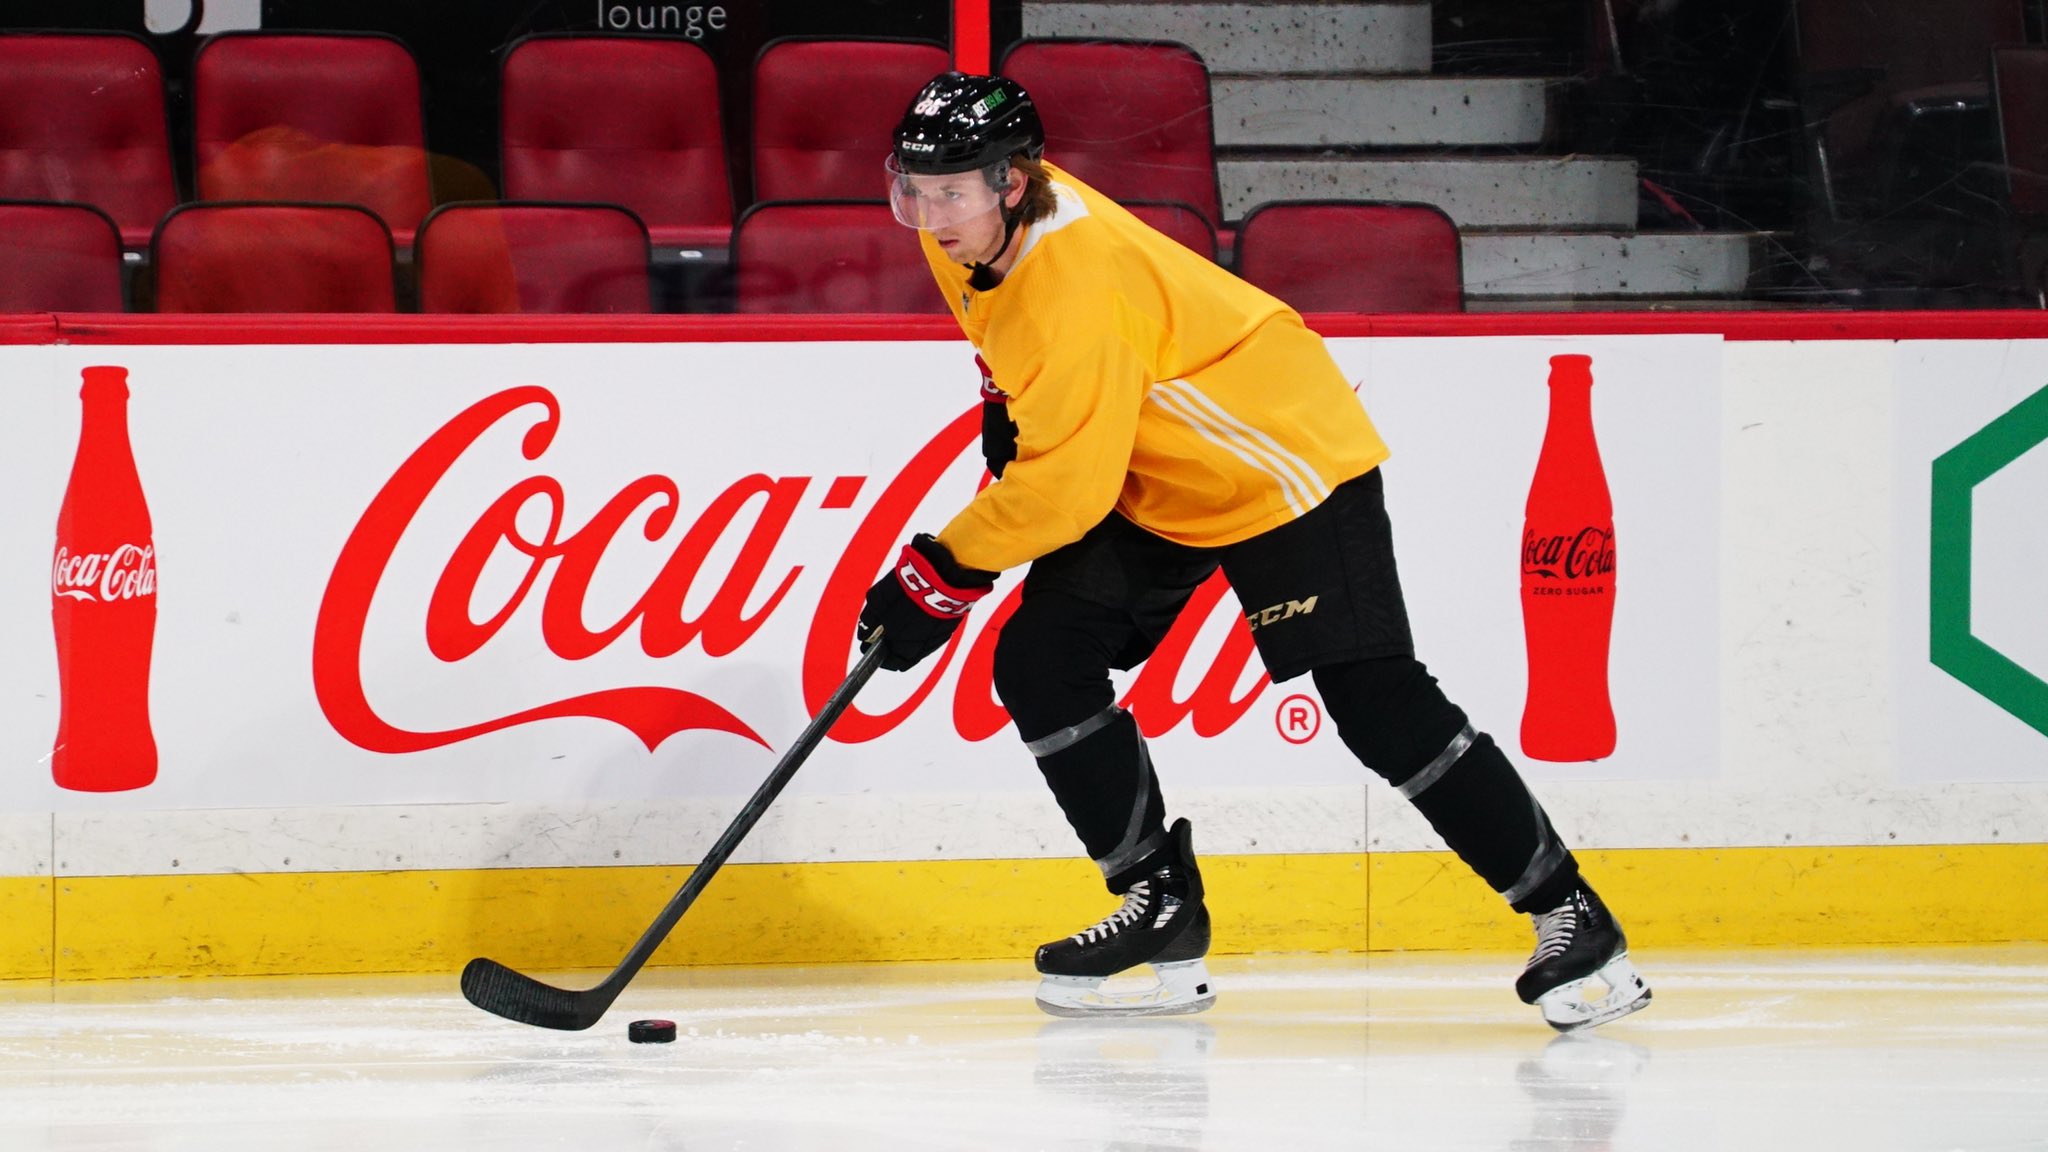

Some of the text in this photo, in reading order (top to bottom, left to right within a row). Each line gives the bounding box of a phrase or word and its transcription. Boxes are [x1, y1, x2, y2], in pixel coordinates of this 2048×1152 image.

[598, 0, 727, 38] lounge
[902, 141, 935, 152] CCM
[312, 384, 1272, 754] Coca-Ca
[1522, 526, 1615, 580] Coca-Cola
[53, 543, 157, 603] Coca-Cola
[1533, 586, 1604, 595] ZERO SUGAR
[1246, 595, 1319, 632] CCM
